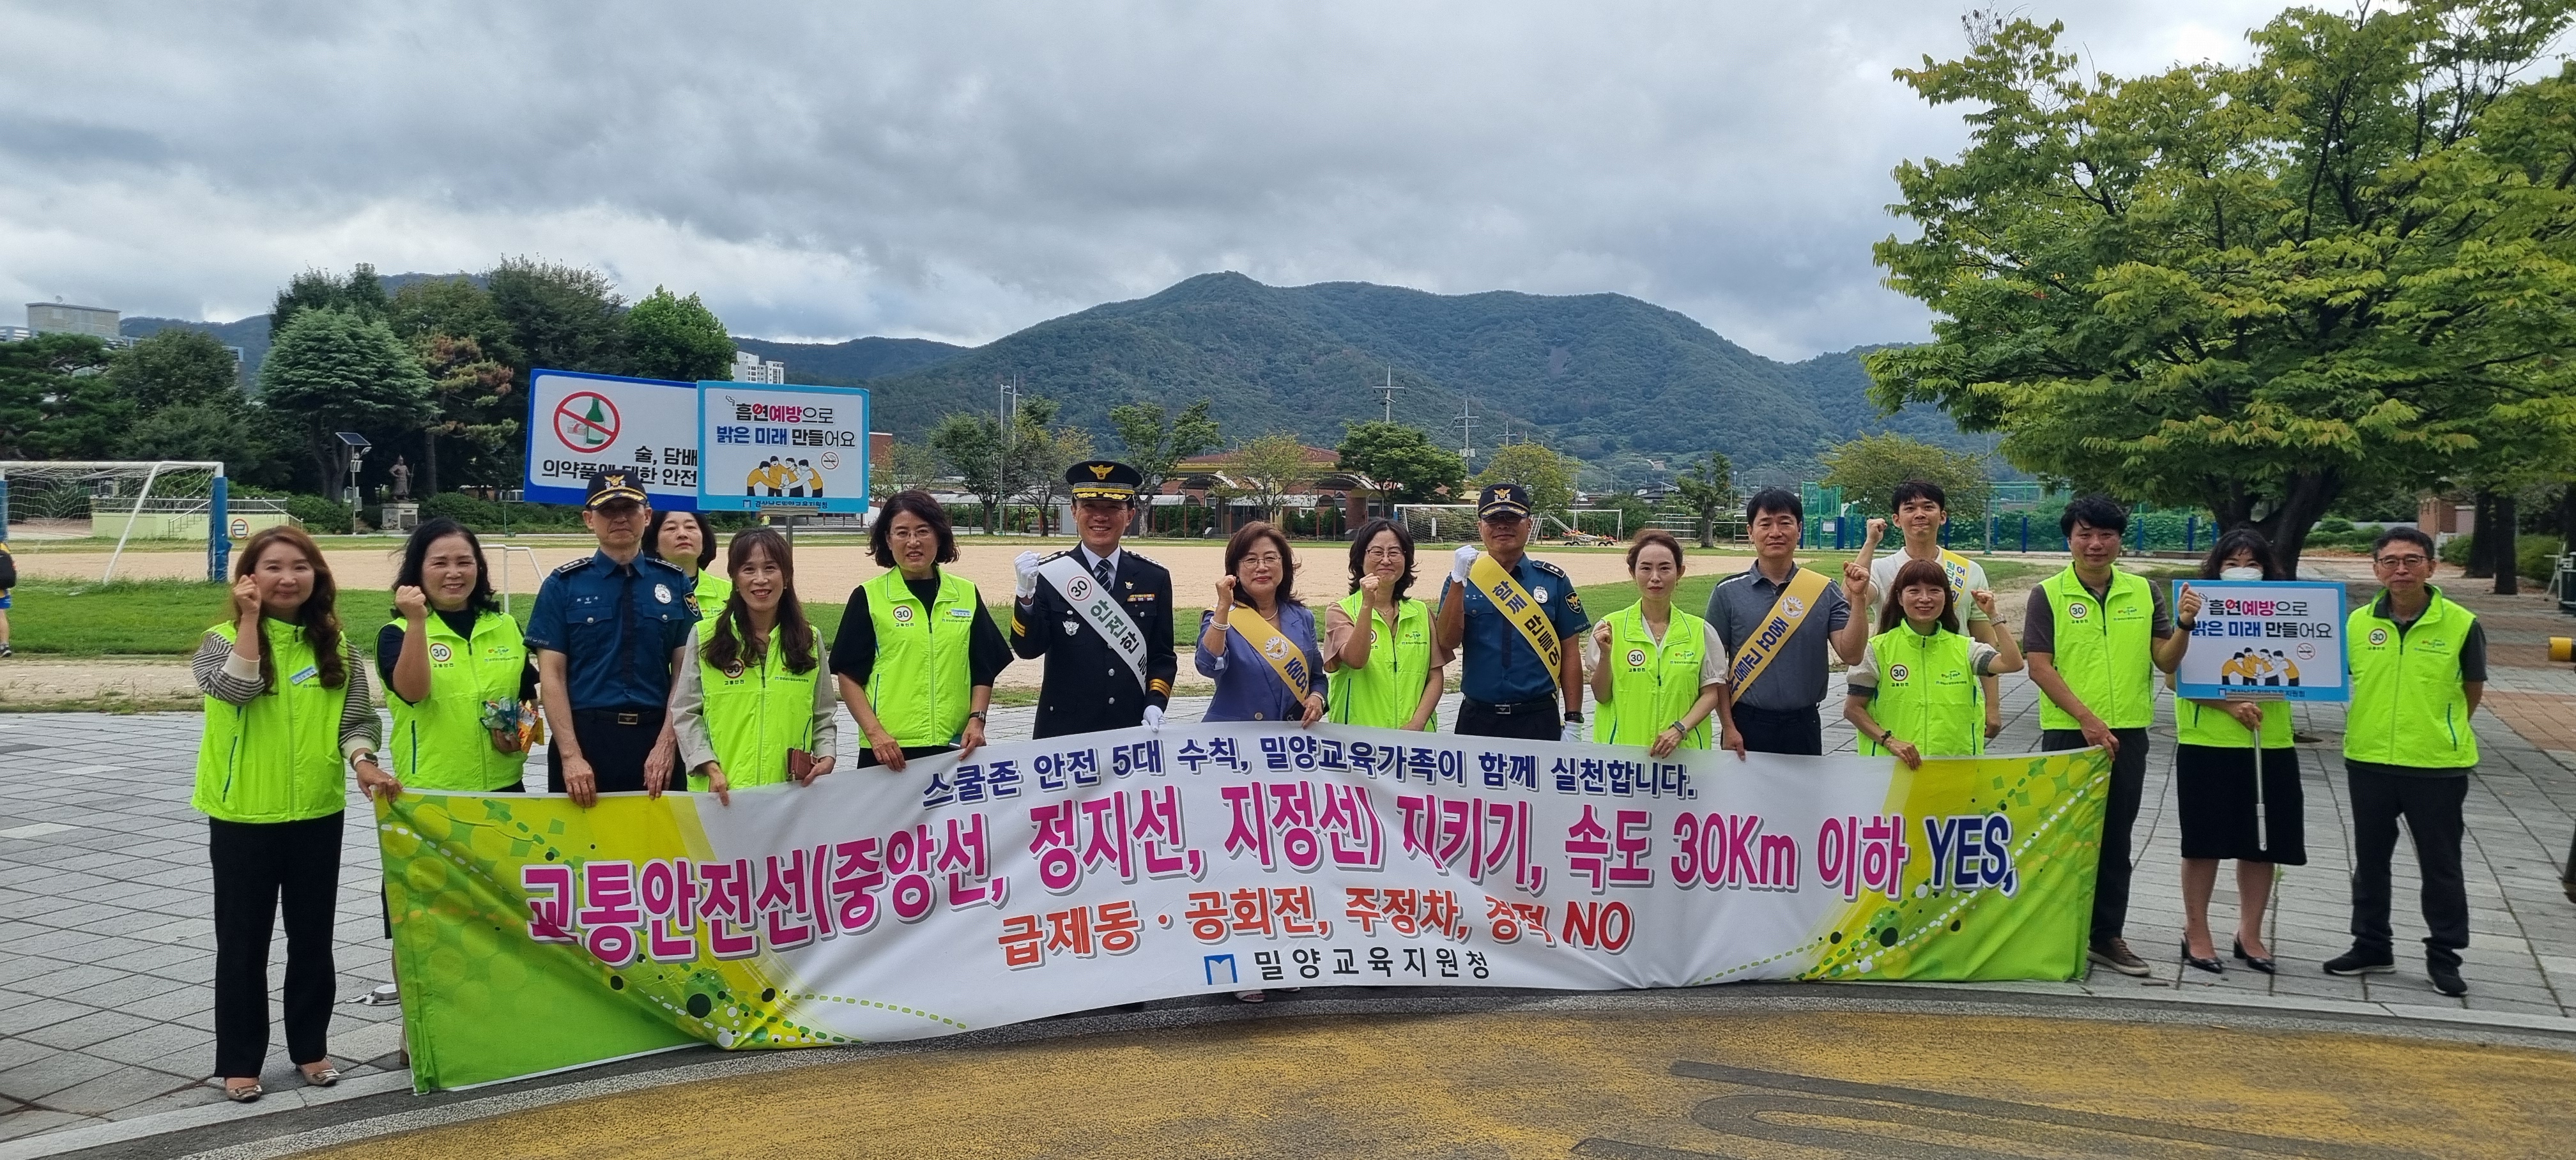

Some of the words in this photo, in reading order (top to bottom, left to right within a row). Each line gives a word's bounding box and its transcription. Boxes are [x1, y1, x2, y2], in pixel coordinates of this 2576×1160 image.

[735, 403, 834, 424] 흡연예방으로
[717, 425, 750, 444] 밝은
[755, 427, 787, 445] 미래
[792, 429, 855, 447] 만들어요
[634, 445, 657, 466] 술,
[664, 447, 698, 467] 담배
[663, 468, 697, 487] 안전
[1071, 580, 1087, 597] 30
[1492, 580, 1528, 614] 함께
[2209, 599, 2308, 616] 흡연예방으로
[1090, 599, 1140, 654] 안전한
[1756, 616, 1790, 652] 중요
[2228, 621, 2260, 637] 미래
[2266, 622, 2332, 638] 만들어요
[433, 648, 447, 657] 30
[1893, 669, 1905, 677] 30
[923, 761, 1019, 807] 스쿨존
[1034, 749, 1097, 789] 안전
[1113, 740, 1162, 775] 5대
[1177, 738, 1248, 770] 수칙,
[1261, 736, 1465, 784] 밀양교육가족이
[1478, 752, 1536, 788] 함께
[1551, 758, 1695, 796] 실천합니다.
[525, 814, 1004, 963] 교통안전선(중앙선,
[1030, 786, 1200, 889] 정지선,
[1222, 781, 1381, 867] 지정선)
[1397, 795, 1542, 890] 지키기,
[1565, 805, 1650, 888] 속도
[1671, 813, 1795, 887] 30Km
[1818, 816, 1905, 896] 이하
[1926, 818, 2014, 893] YES,
[998, 901, 1138, 966] 급제동
[1185, 887, 1328, 940] 공회전,
[1346, 889, 1468, 940] 주정차,
[1562, 902, 1630, 950] NO
[1254, 947, 1490, 981] 밀양교육지원청
